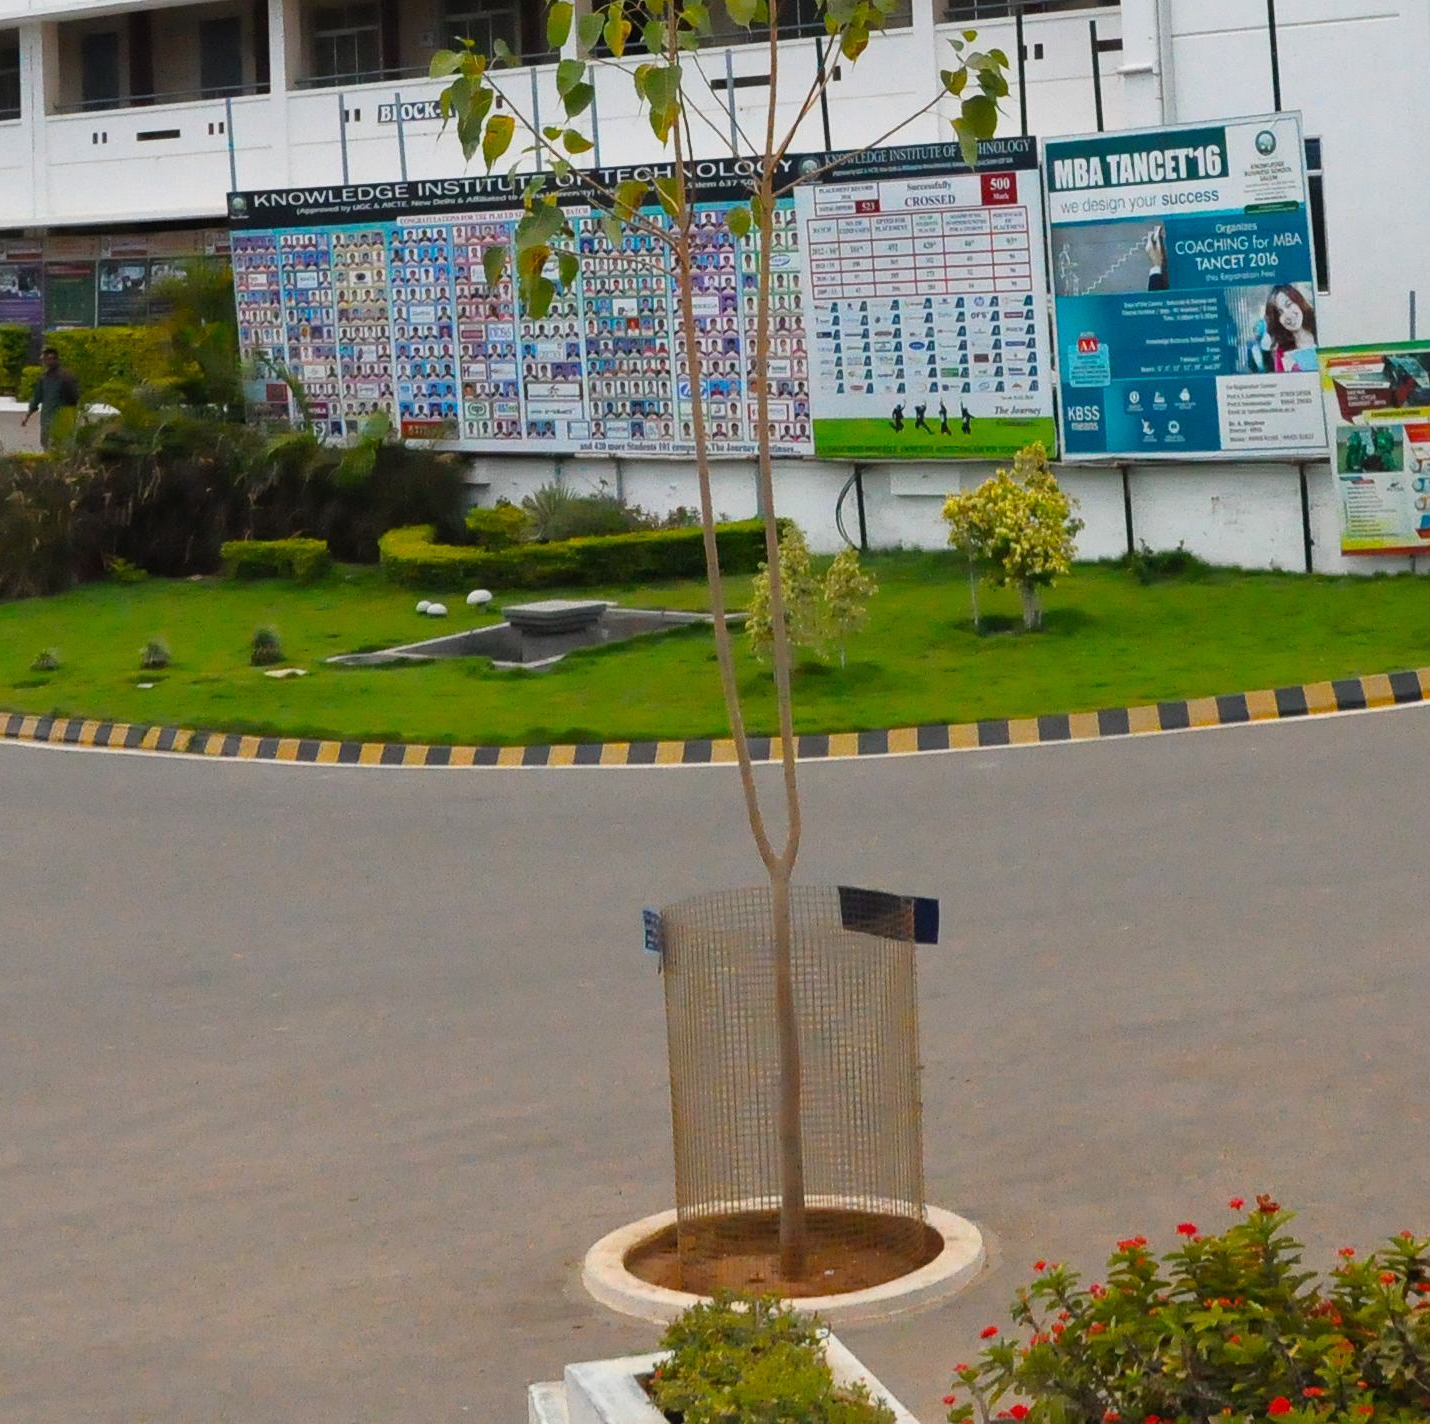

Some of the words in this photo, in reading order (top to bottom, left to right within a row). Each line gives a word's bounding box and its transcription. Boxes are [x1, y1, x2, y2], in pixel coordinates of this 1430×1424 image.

[824, 149, 888, 166] KNOWLEDGE
[889, 145, 942, 162] INSTITUTE
[942, 144, 957, 158] OF
[959, 139, 1031, 156] HNOLOGY
[1053, 156, 1104, 189] MBA
[1106, 144, 1222, 185] TANCET'16
[719, 179, 737, 187] 637
[907, 180, 951, 192] Successfully
[990, 177, 1010, 190] 500
[254, 183, 409, 208] KNOWLEDGE
[904, 194, 956, 208] CROSSED
[1061, 201, 1079, 214] we
[1082, 197, 1126, 214] design
[1128, 195, 1157, 213] your
[1161, 190, 1220, 206] success
[340, 204, 351, 213] by
[352, 202, 371, 211] UGC
[1215, 222, 1258, 234] Organizes
[1175, 236, 1249, 254] COACHING
[1252, 234, 1270, 249] for
[1273, 232, 1302, 247] MBA
[1195, 254, 1246, 271] TANCET
[1249, 251, 1279, 268] 2016
[1067, 405, 1100, 422] KBSS
